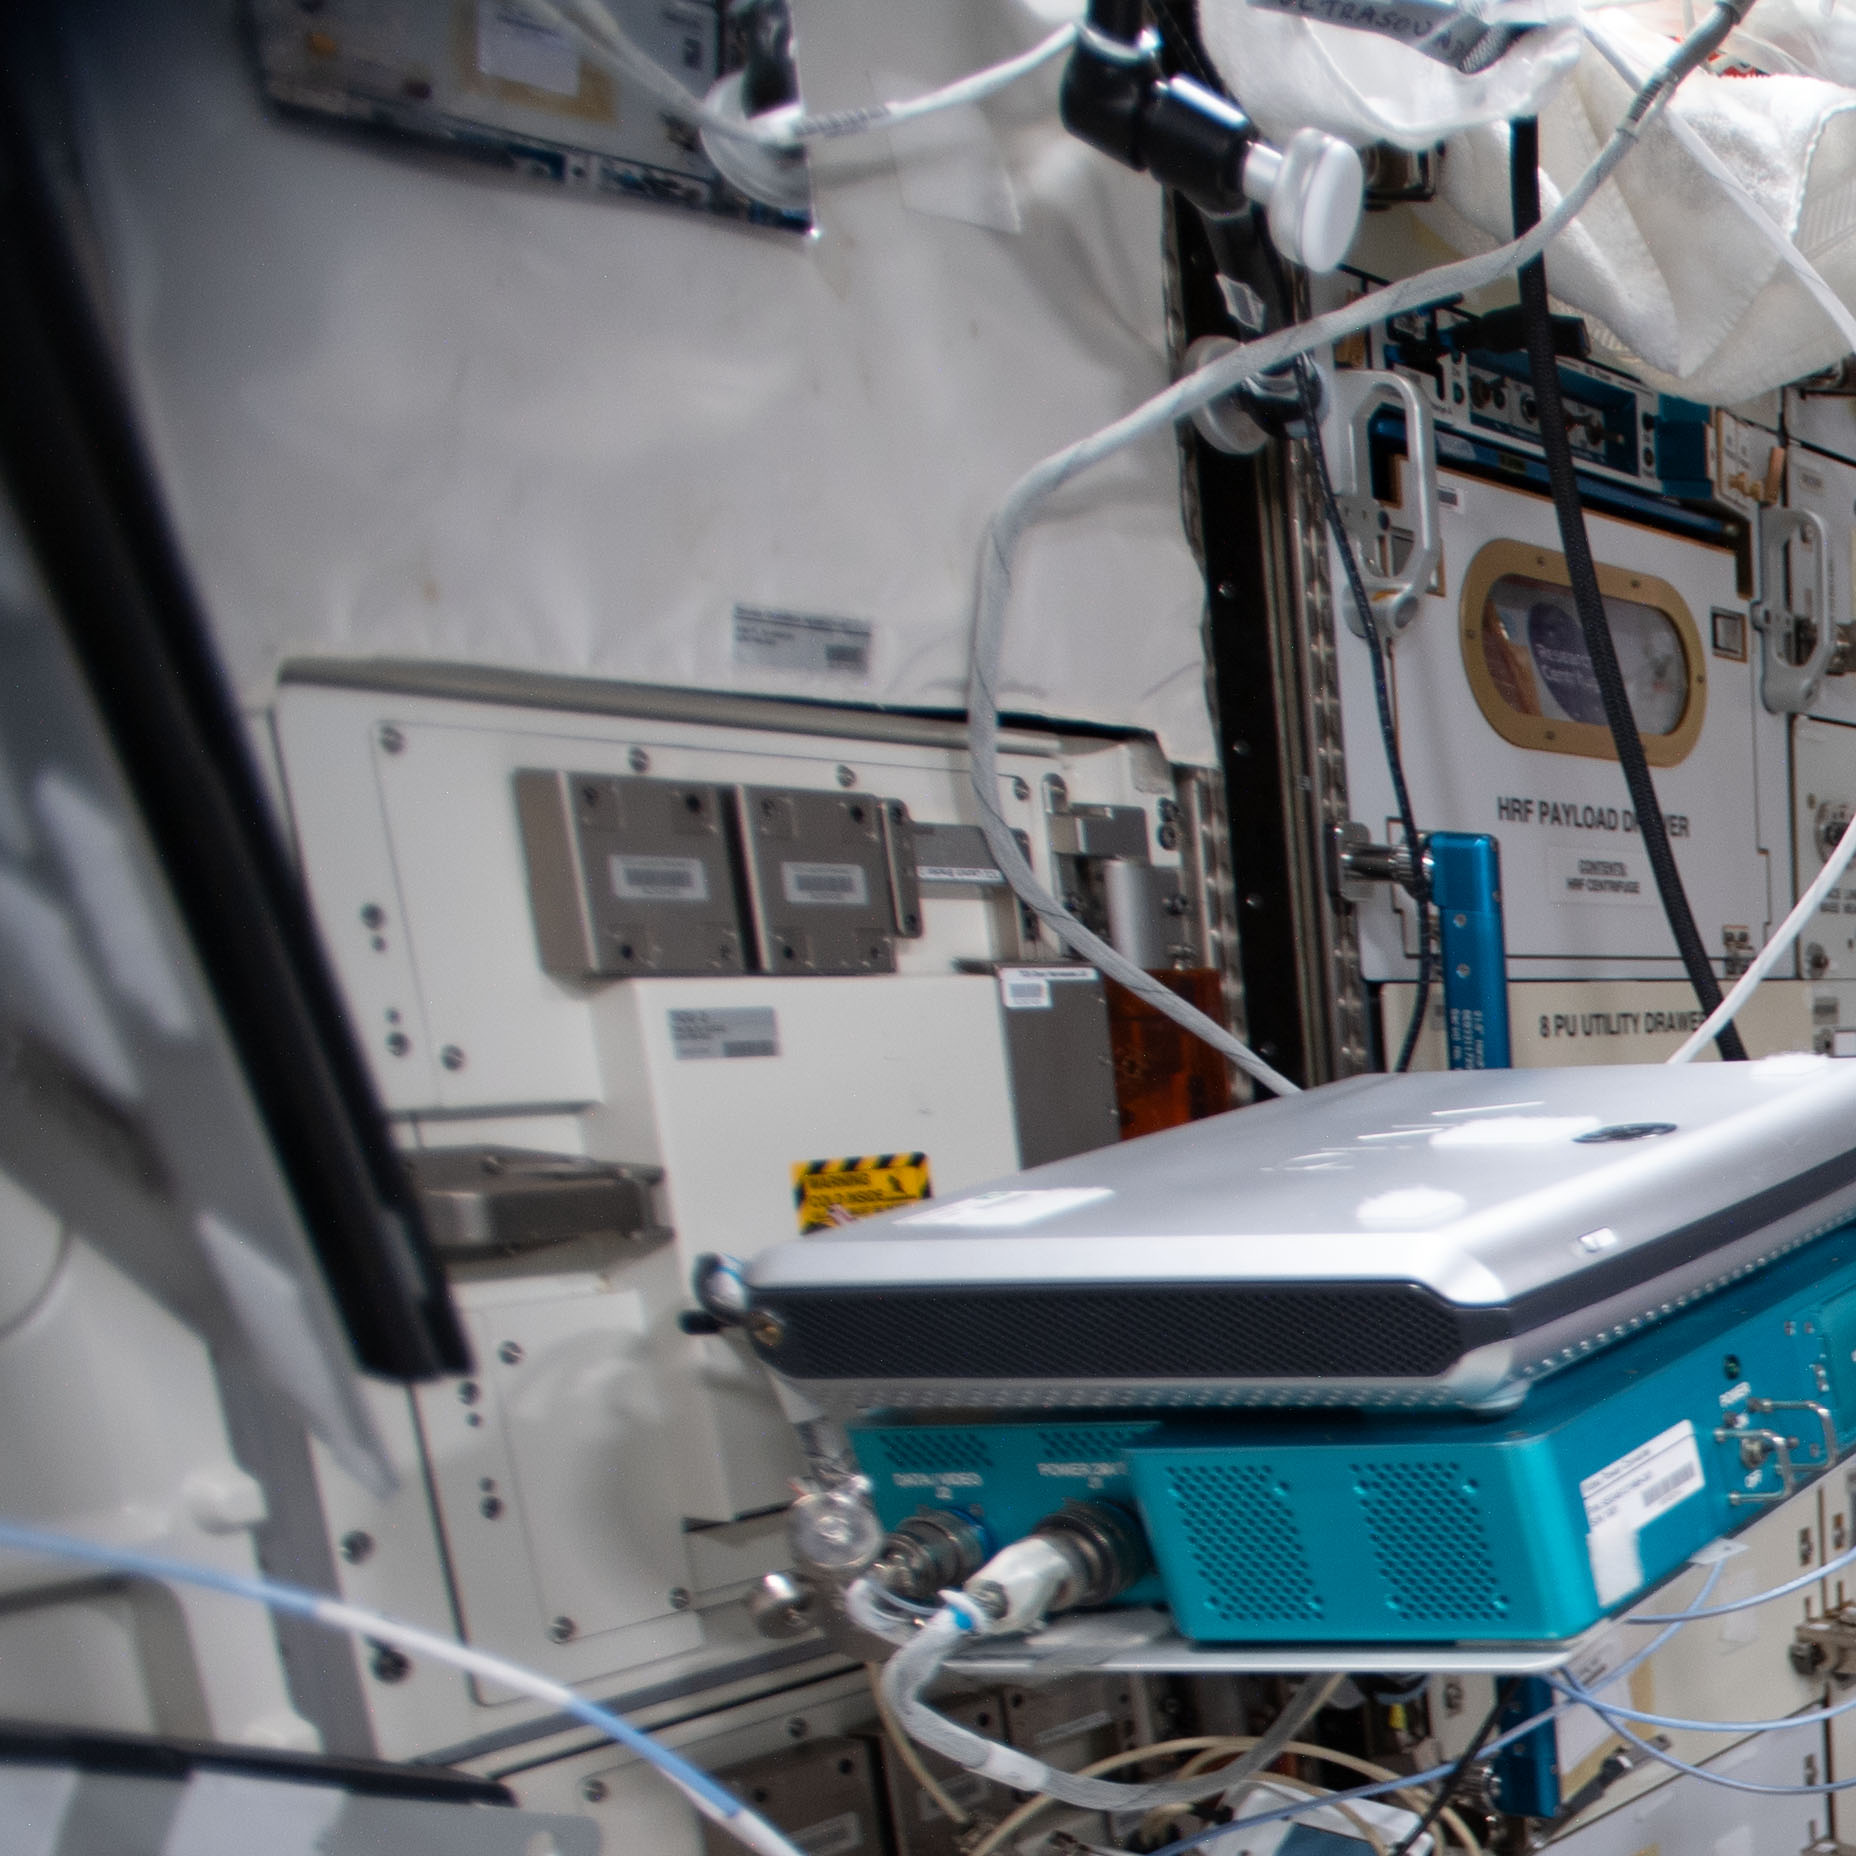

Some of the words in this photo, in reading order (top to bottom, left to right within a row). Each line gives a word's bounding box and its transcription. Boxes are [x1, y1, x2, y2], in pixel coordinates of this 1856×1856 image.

[1496, 796, 1535, 823] HRF
[1558, 799, 1639, 833] PAYLOAD
[1537, 1011, 1551, 1037] 8
[1552, 1010, 1578, 1036] PU
[1581, 1008, 1640, 1036] UTILITY
